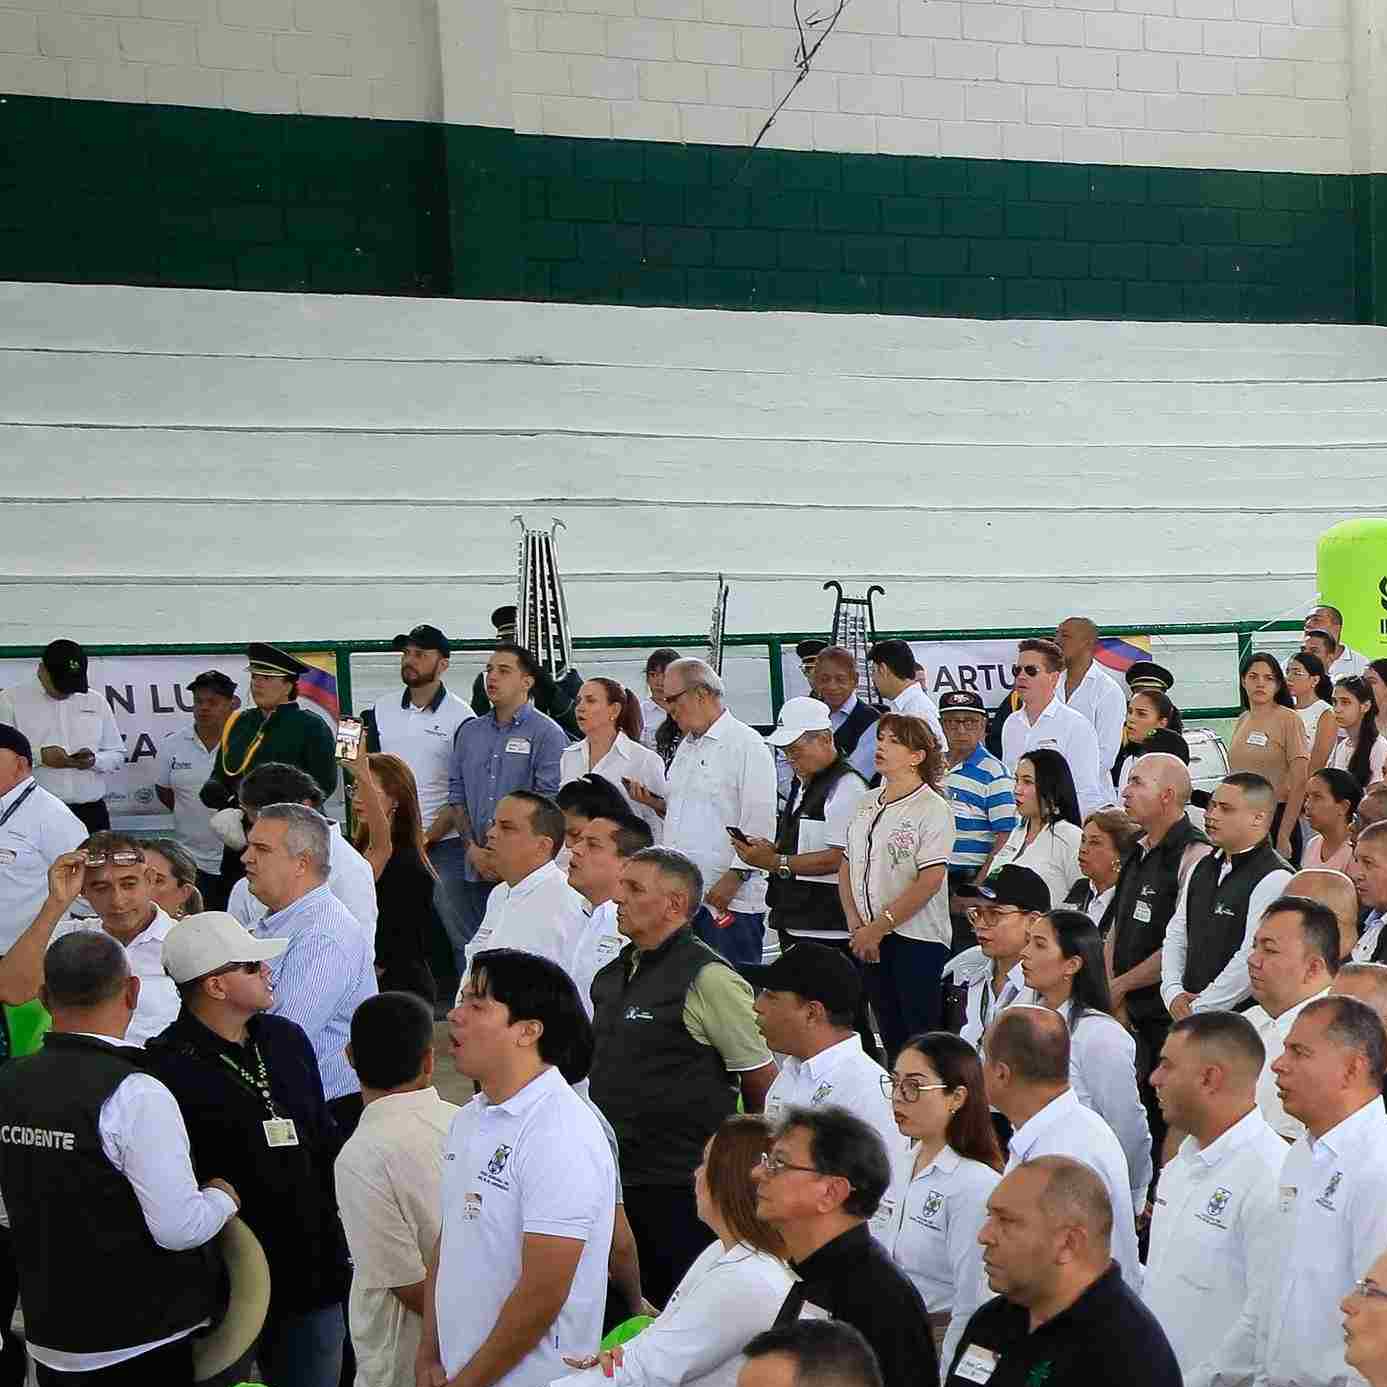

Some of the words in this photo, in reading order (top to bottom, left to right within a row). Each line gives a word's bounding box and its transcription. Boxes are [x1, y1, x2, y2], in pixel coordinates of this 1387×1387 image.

[934, 665, 1016, 692] ARTU
[152, 684, 195, 713] LU
[0, 1126, 75, 1151] CCIDENTE
